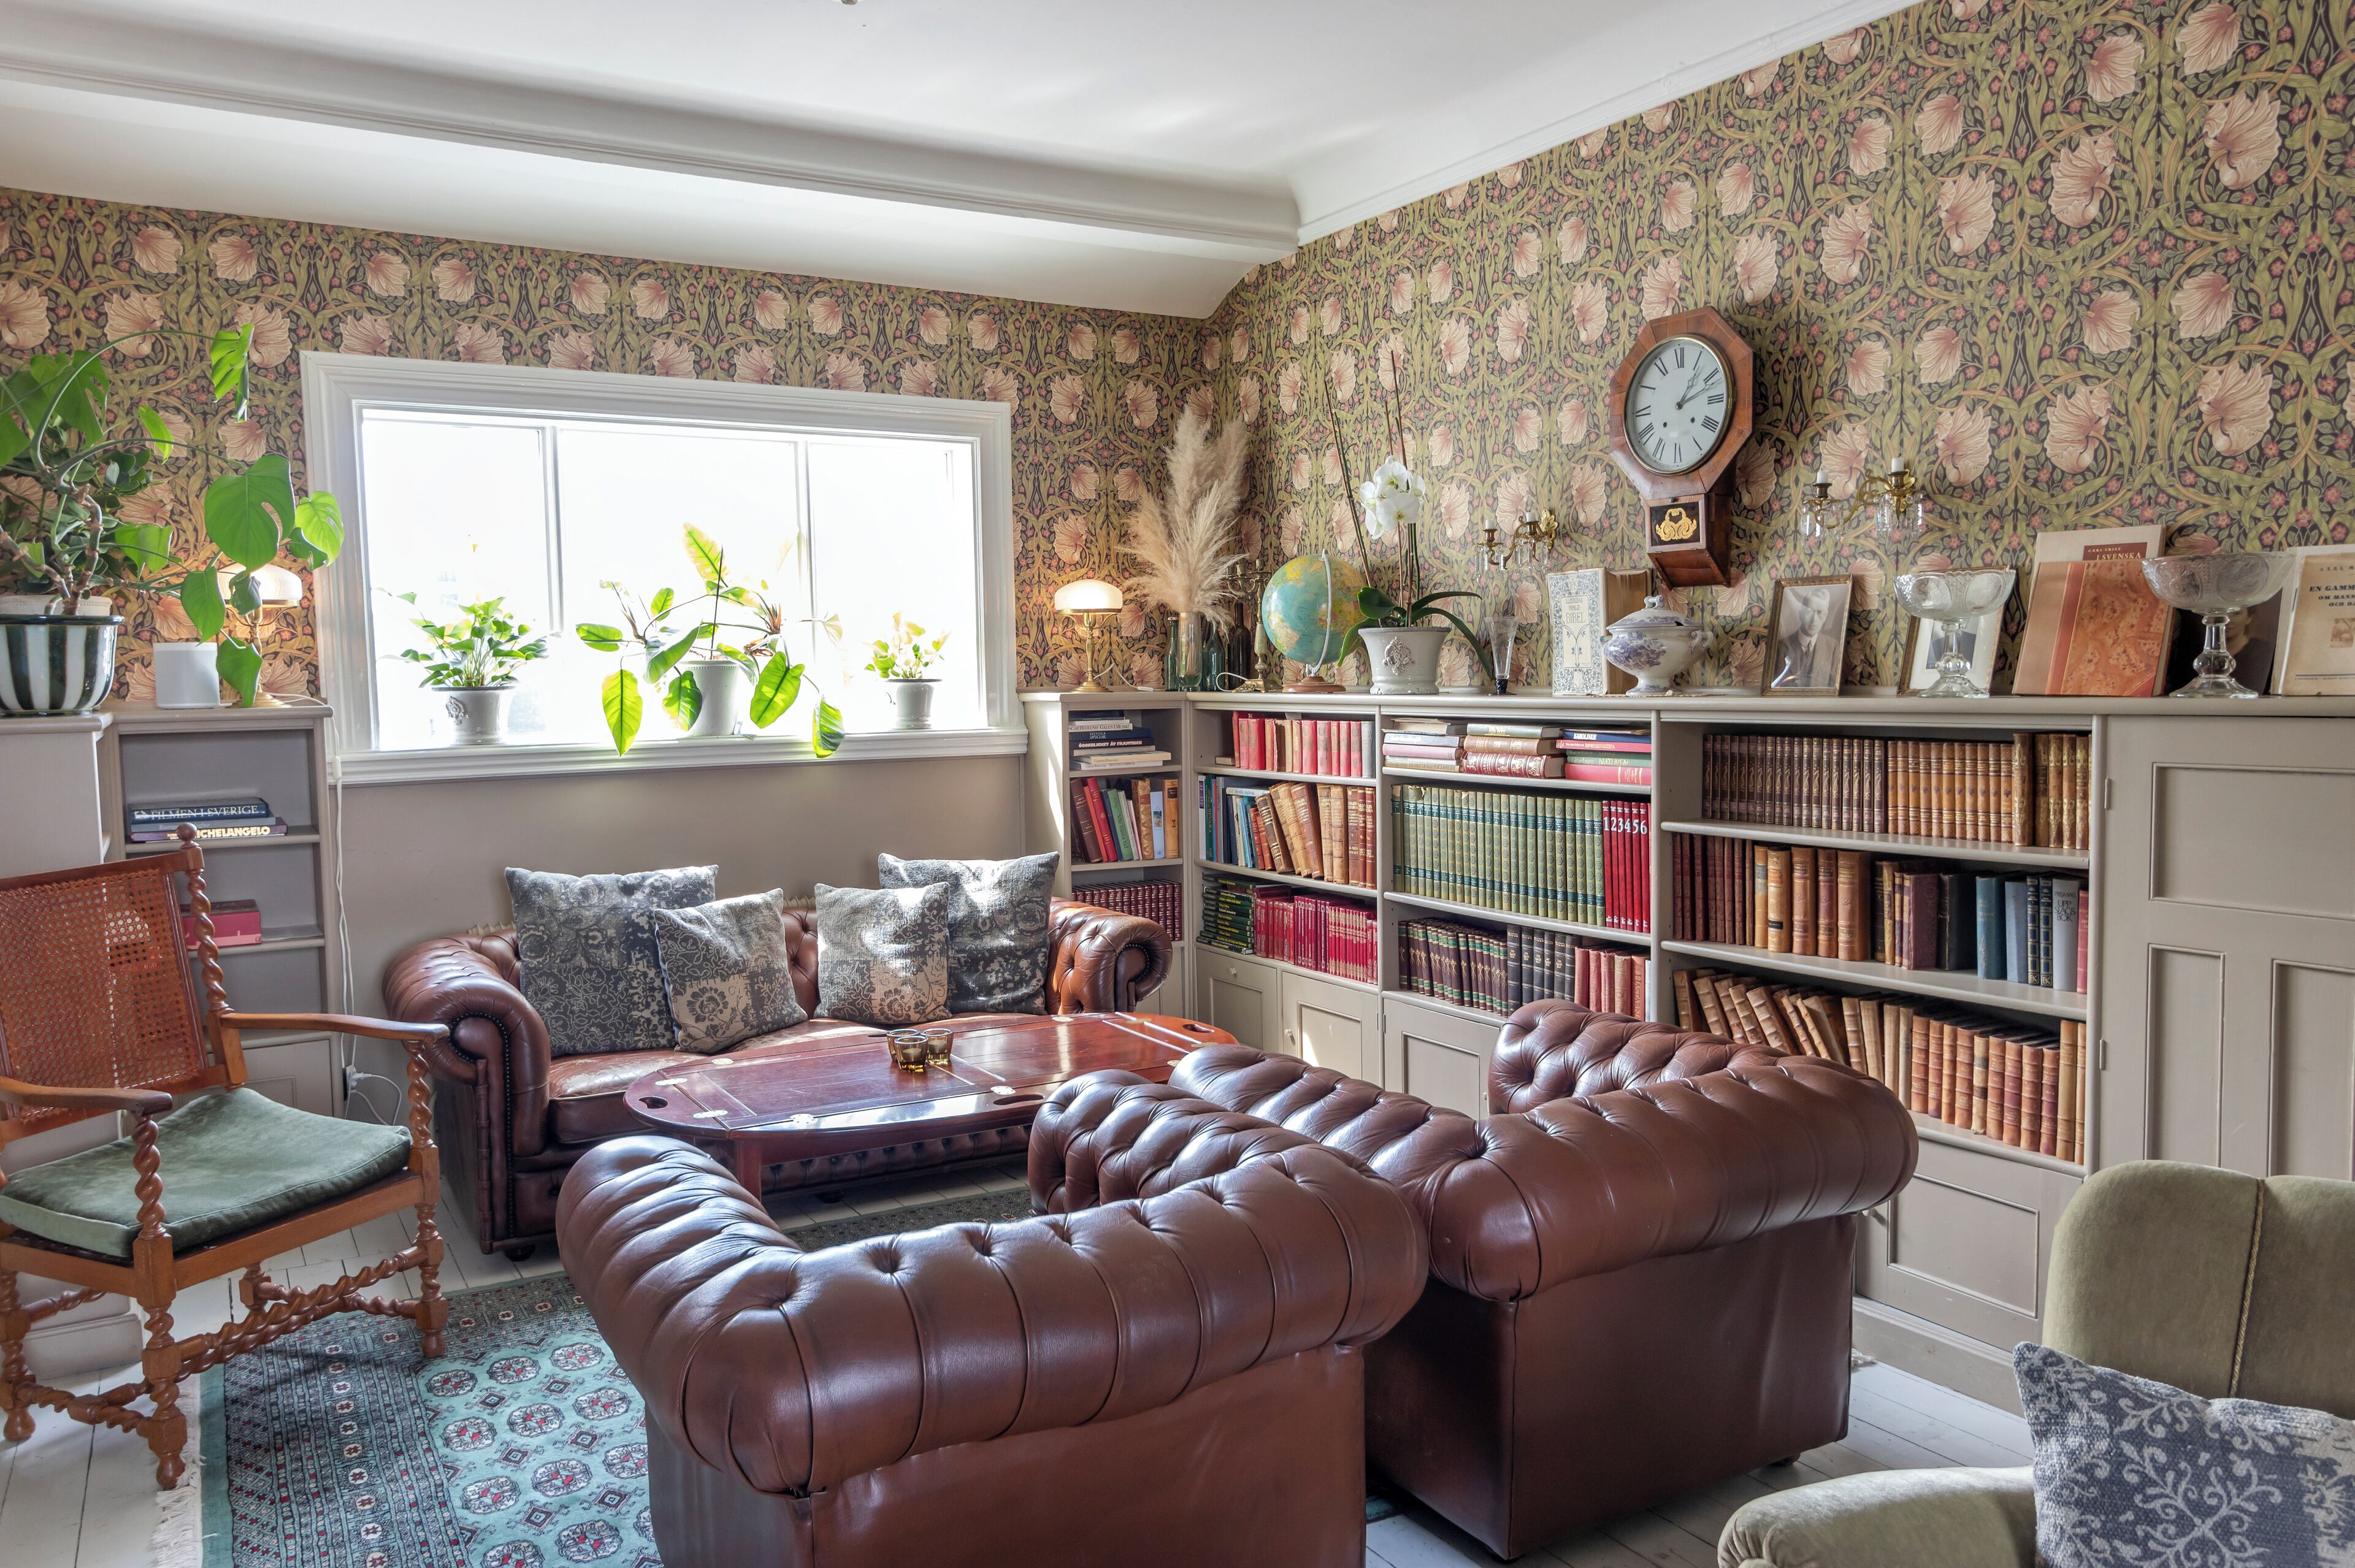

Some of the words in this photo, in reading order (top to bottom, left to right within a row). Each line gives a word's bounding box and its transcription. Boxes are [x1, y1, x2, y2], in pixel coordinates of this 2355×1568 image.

[1703, 367, 1719, 384] II
[1707, 393, 1724, 405] III
[1566, 612, 1585, 623] BIBEL
[151, 809, 197, 820] FILMEN
[201, 809, 204, 818] I
[207, 805, 258, 817] SVERIGE
[1603, 817, 1609, 831] 1
[1610, 817, 1617, 831] 2
[1618, 818, 1624, 832] 3
[1625, 818, 1631, 832] 4
[1633, 819, 1639, 834] 5
[1641, 820, 1648, 834] 6
[195, 826, 270, 839] ICHELANGELO
[2057, 914, 2073, 922] BOK
